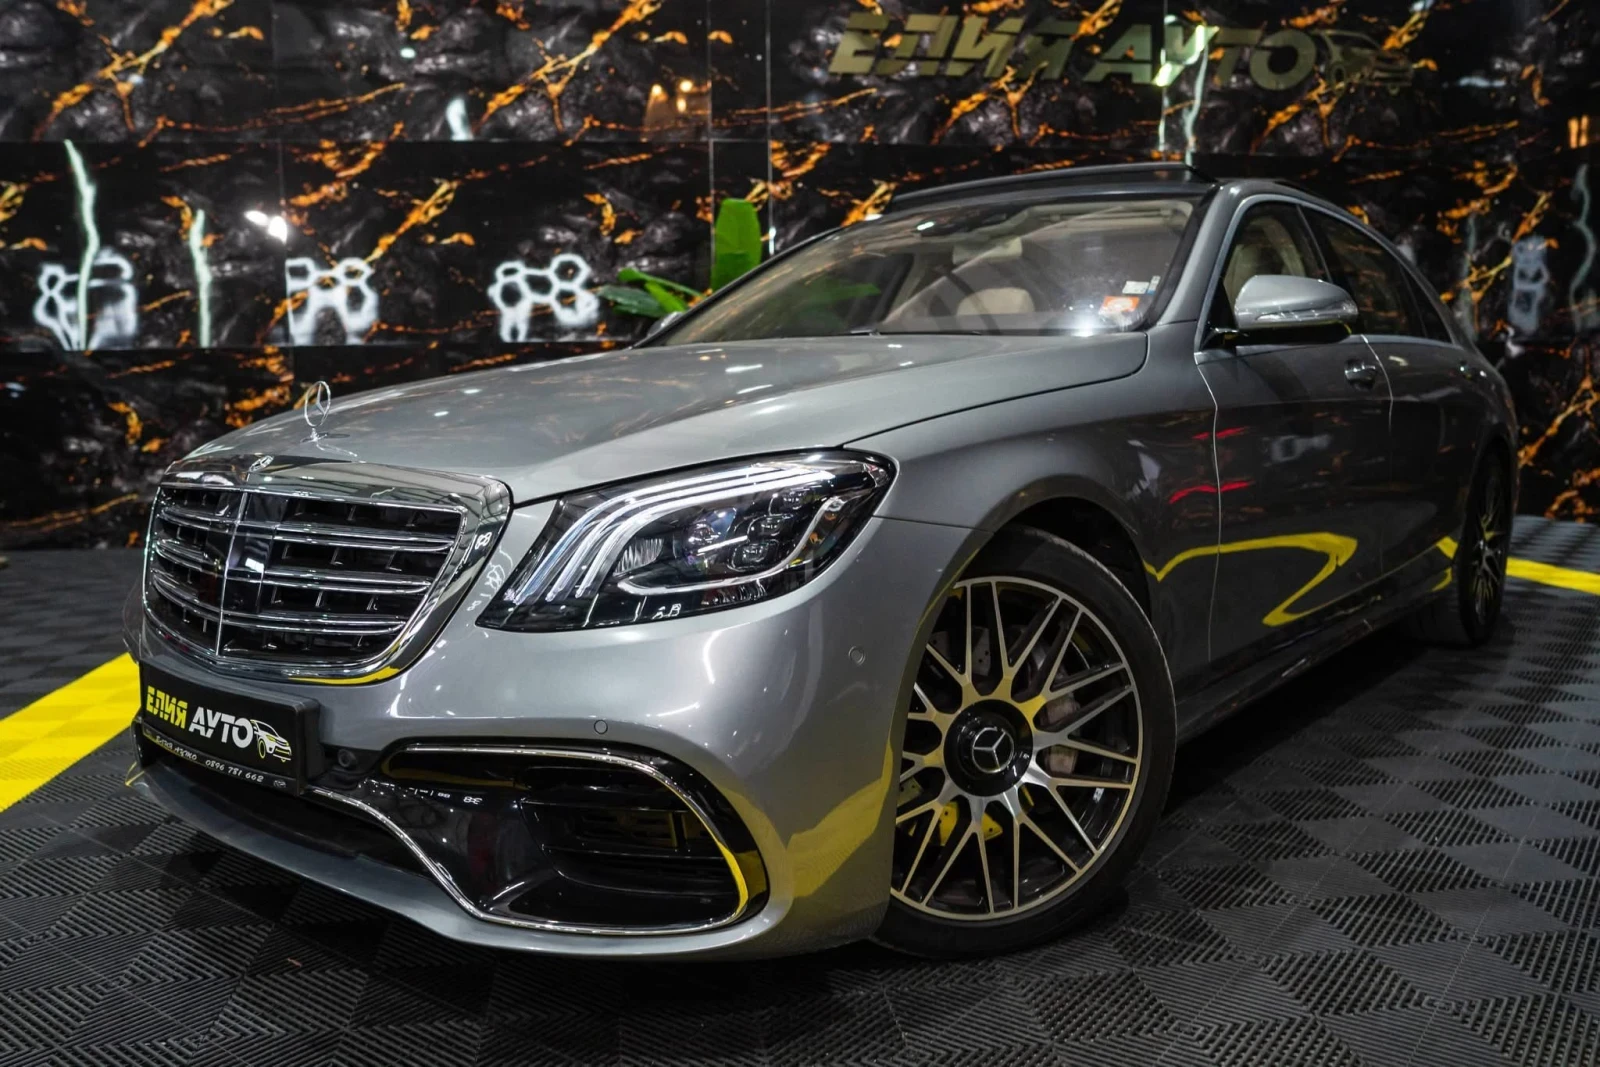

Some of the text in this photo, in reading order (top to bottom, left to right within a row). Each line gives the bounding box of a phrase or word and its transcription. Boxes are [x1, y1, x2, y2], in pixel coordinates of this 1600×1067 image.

[146, 685, 254, 749] ЕЛИЯ АУТО
[205, 759, 225, 771] 0896
[227, 766, 241, 777] 781
[245, 773, 264, 783] 662
